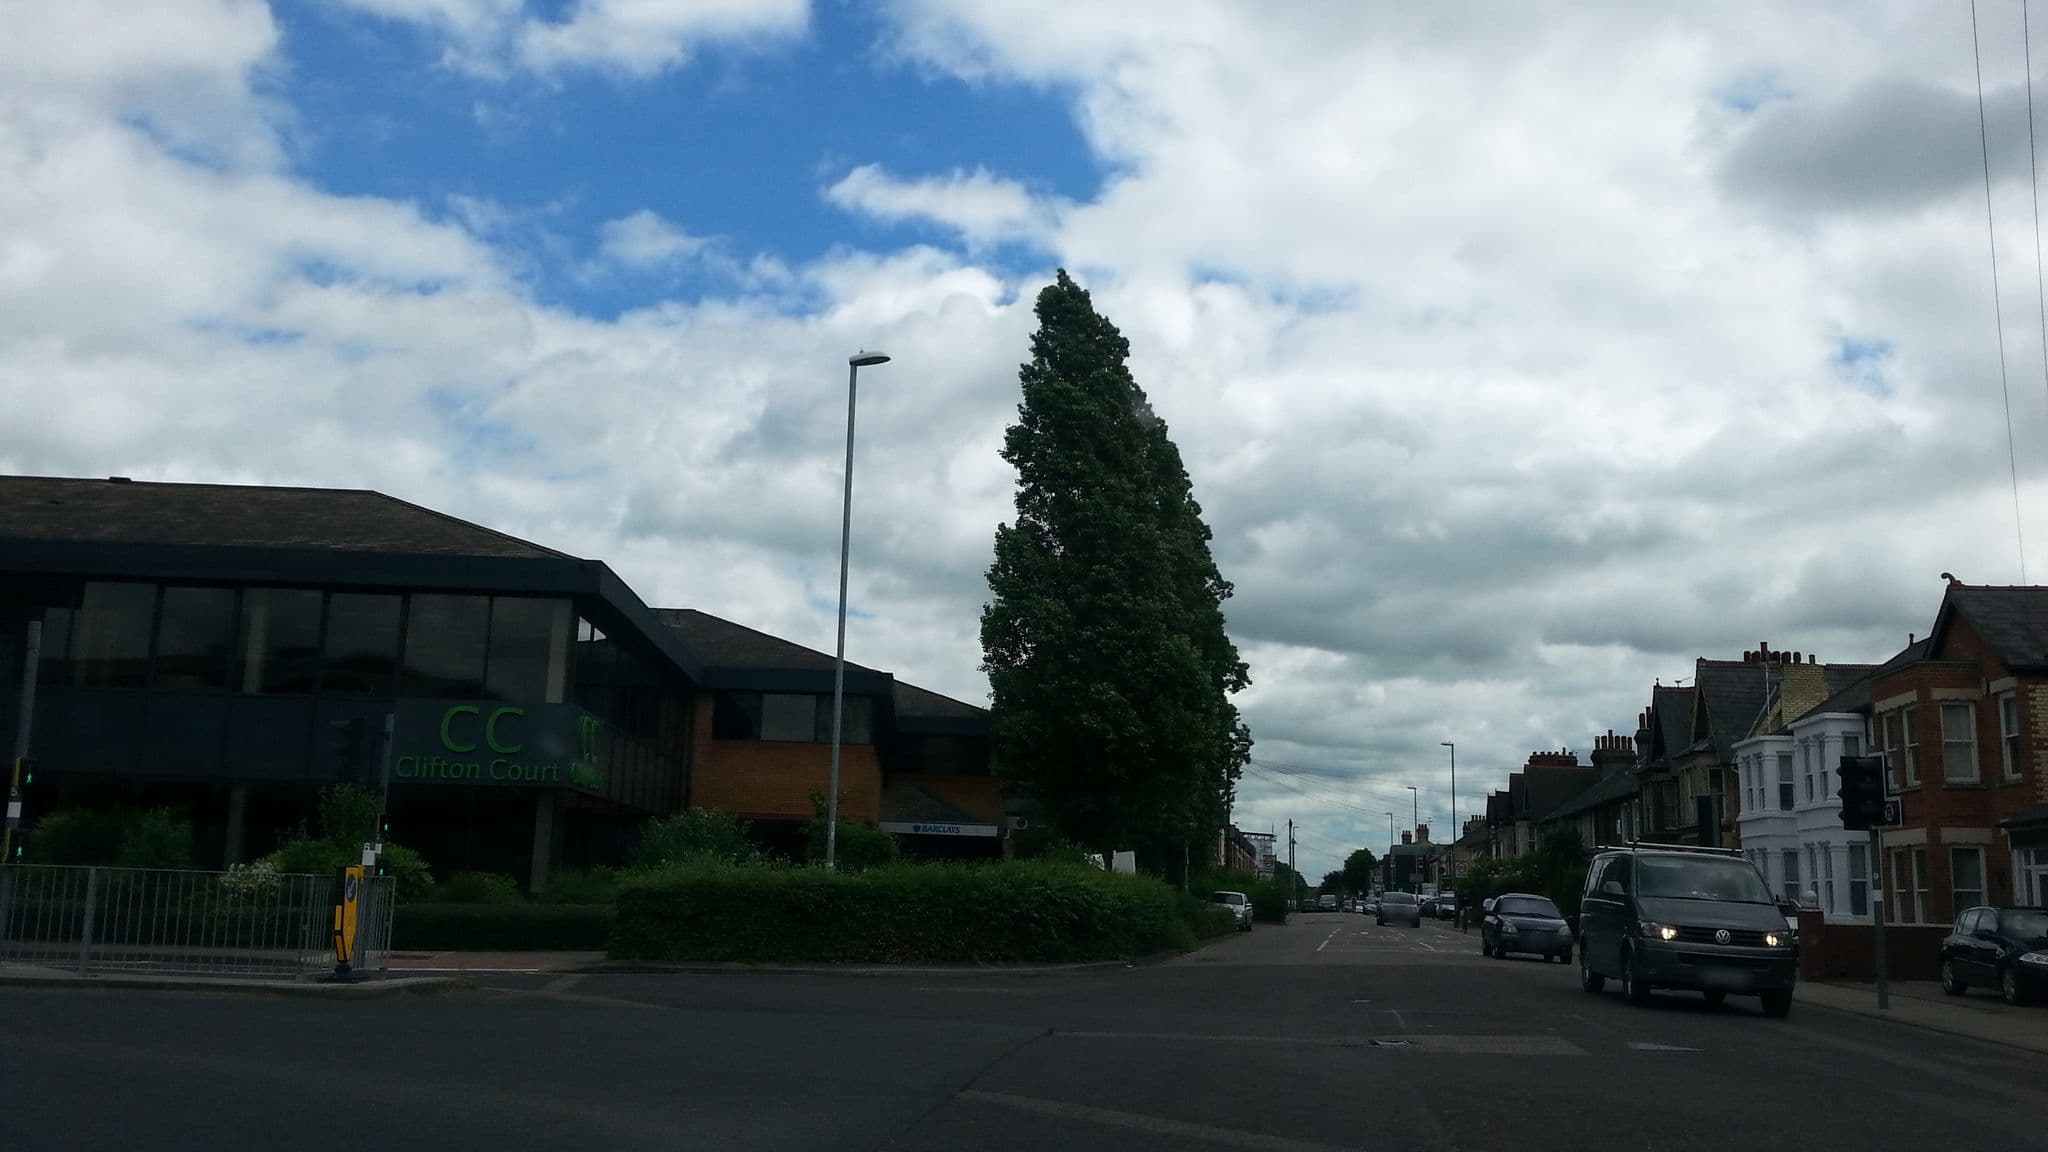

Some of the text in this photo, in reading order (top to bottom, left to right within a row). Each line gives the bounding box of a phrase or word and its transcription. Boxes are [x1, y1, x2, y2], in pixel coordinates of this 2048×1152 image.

[440, 704, 526, 754] CC
[395, 755, 480, 780] Clifton
[489, 758, 561, 782] Court
[921, 824, 961, 833] BARCLAYS
